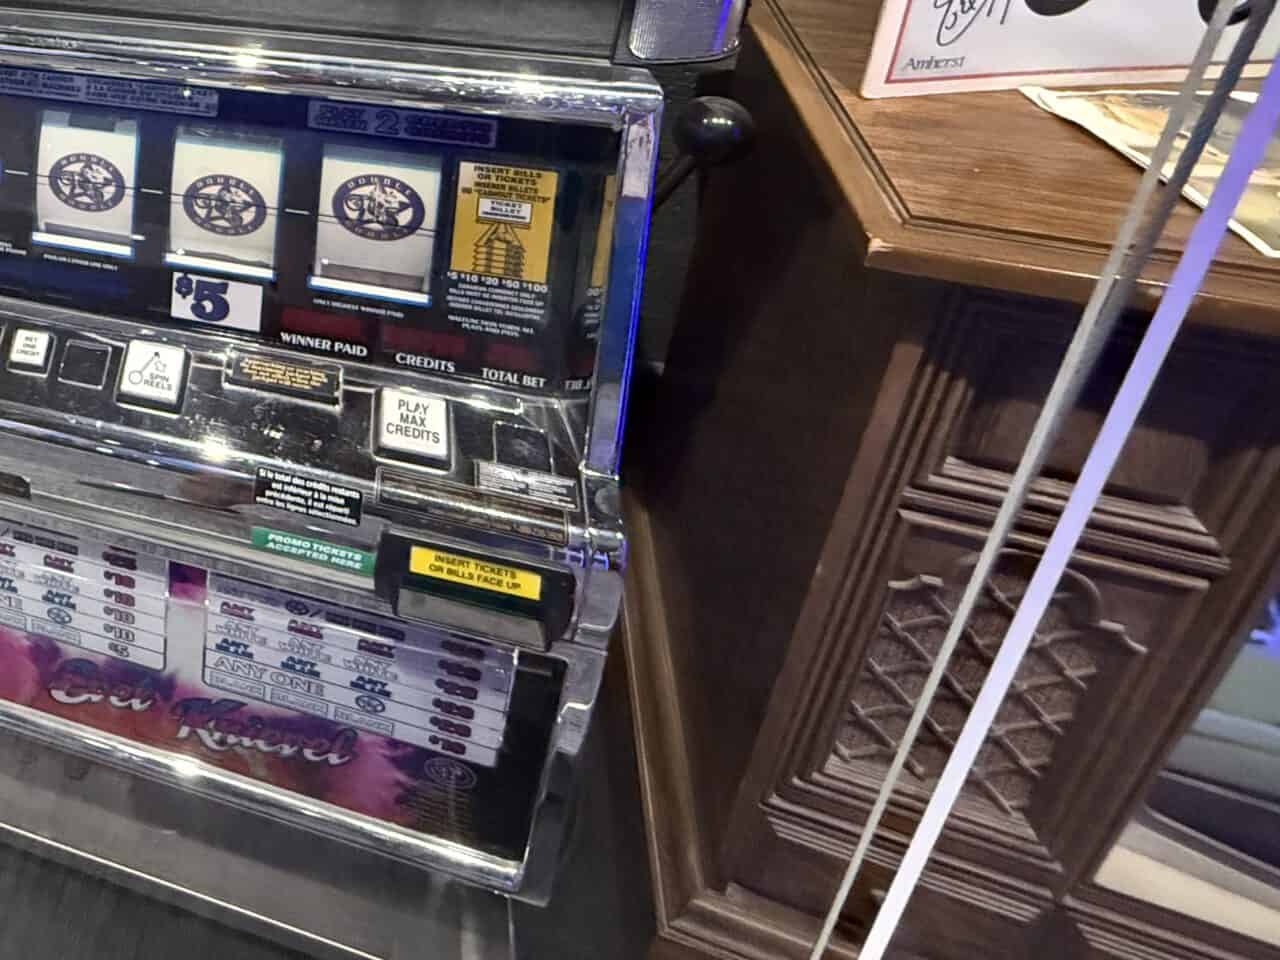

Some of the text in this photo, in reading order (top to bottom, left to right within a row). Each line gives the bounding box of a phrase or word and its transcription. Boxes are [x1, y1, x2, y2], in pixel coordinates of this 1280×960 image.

[903, 56, 966, 71] Amherst
[473, 165, 542, 179] INSERT BILLS
[477, 173, 537, 186] OR TICKETS
[175, 272, 230, 322] $5
[522, 282, 548, 293] $100
[280, 331, 368, 357] WINNER PAID
[395, 352, 456, 373] CREDITS
[150, 372, 170, 383] SPIN
[481, 367, 547, 389] TOTAL BET
[398, 399, 431, 415] PLAY
[399, 412, 427, 428] MAX
[385, 422, 441, 444] CREDITS
[266, 542, 363, 570] ACCEPTED HERE
[267, 533, 362, 560] PROMO TICKETS
[428, 563, 521, 590] OR BILLS FACE UP
[433, 553, 517, 580] INSERT TICKETS
[215, 656, 267, 681] ANY
